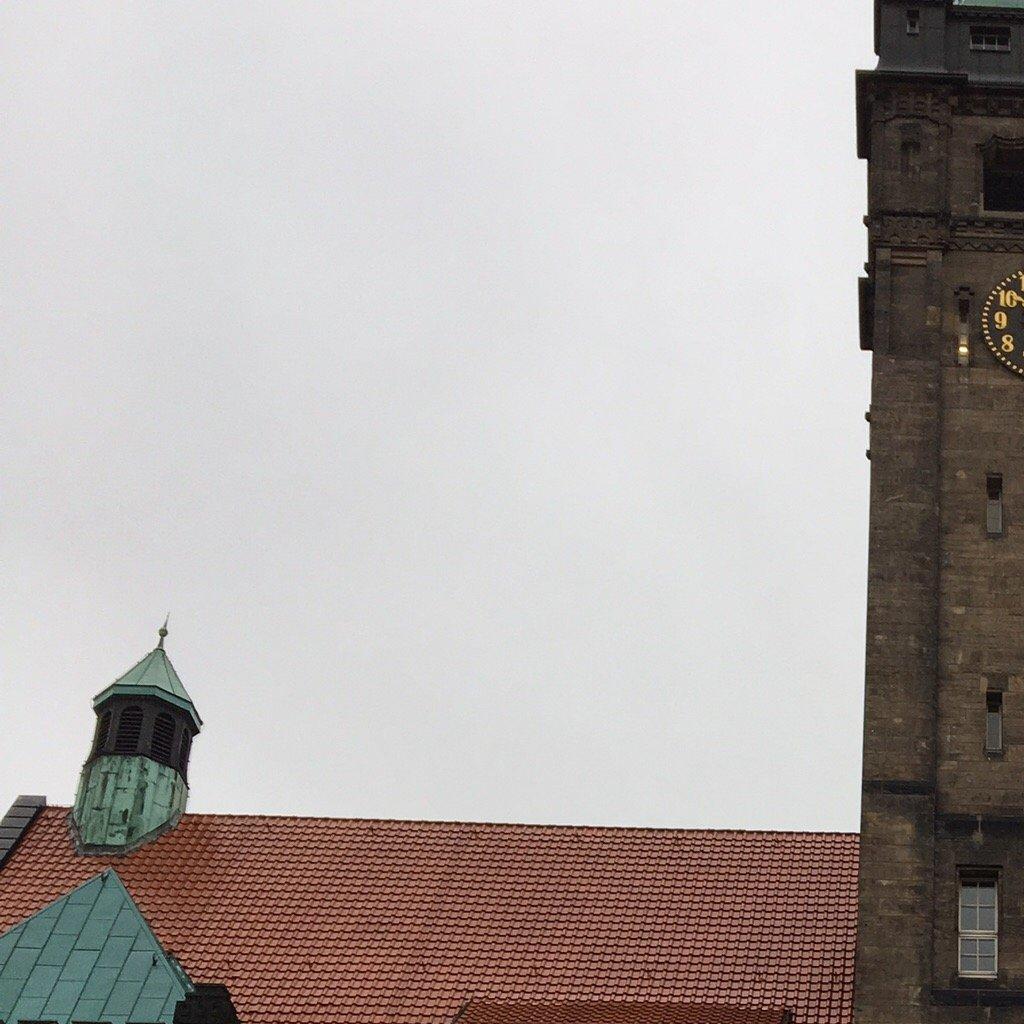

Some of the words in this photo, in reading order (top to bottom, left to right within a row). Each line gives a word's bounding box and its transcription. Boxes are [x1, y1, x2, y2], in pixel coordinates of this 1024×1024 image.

[1000, 290, 1018, 307] 10
[994, 311, 1007, 329] 9
[1002, 335, 1014, 352] 8
